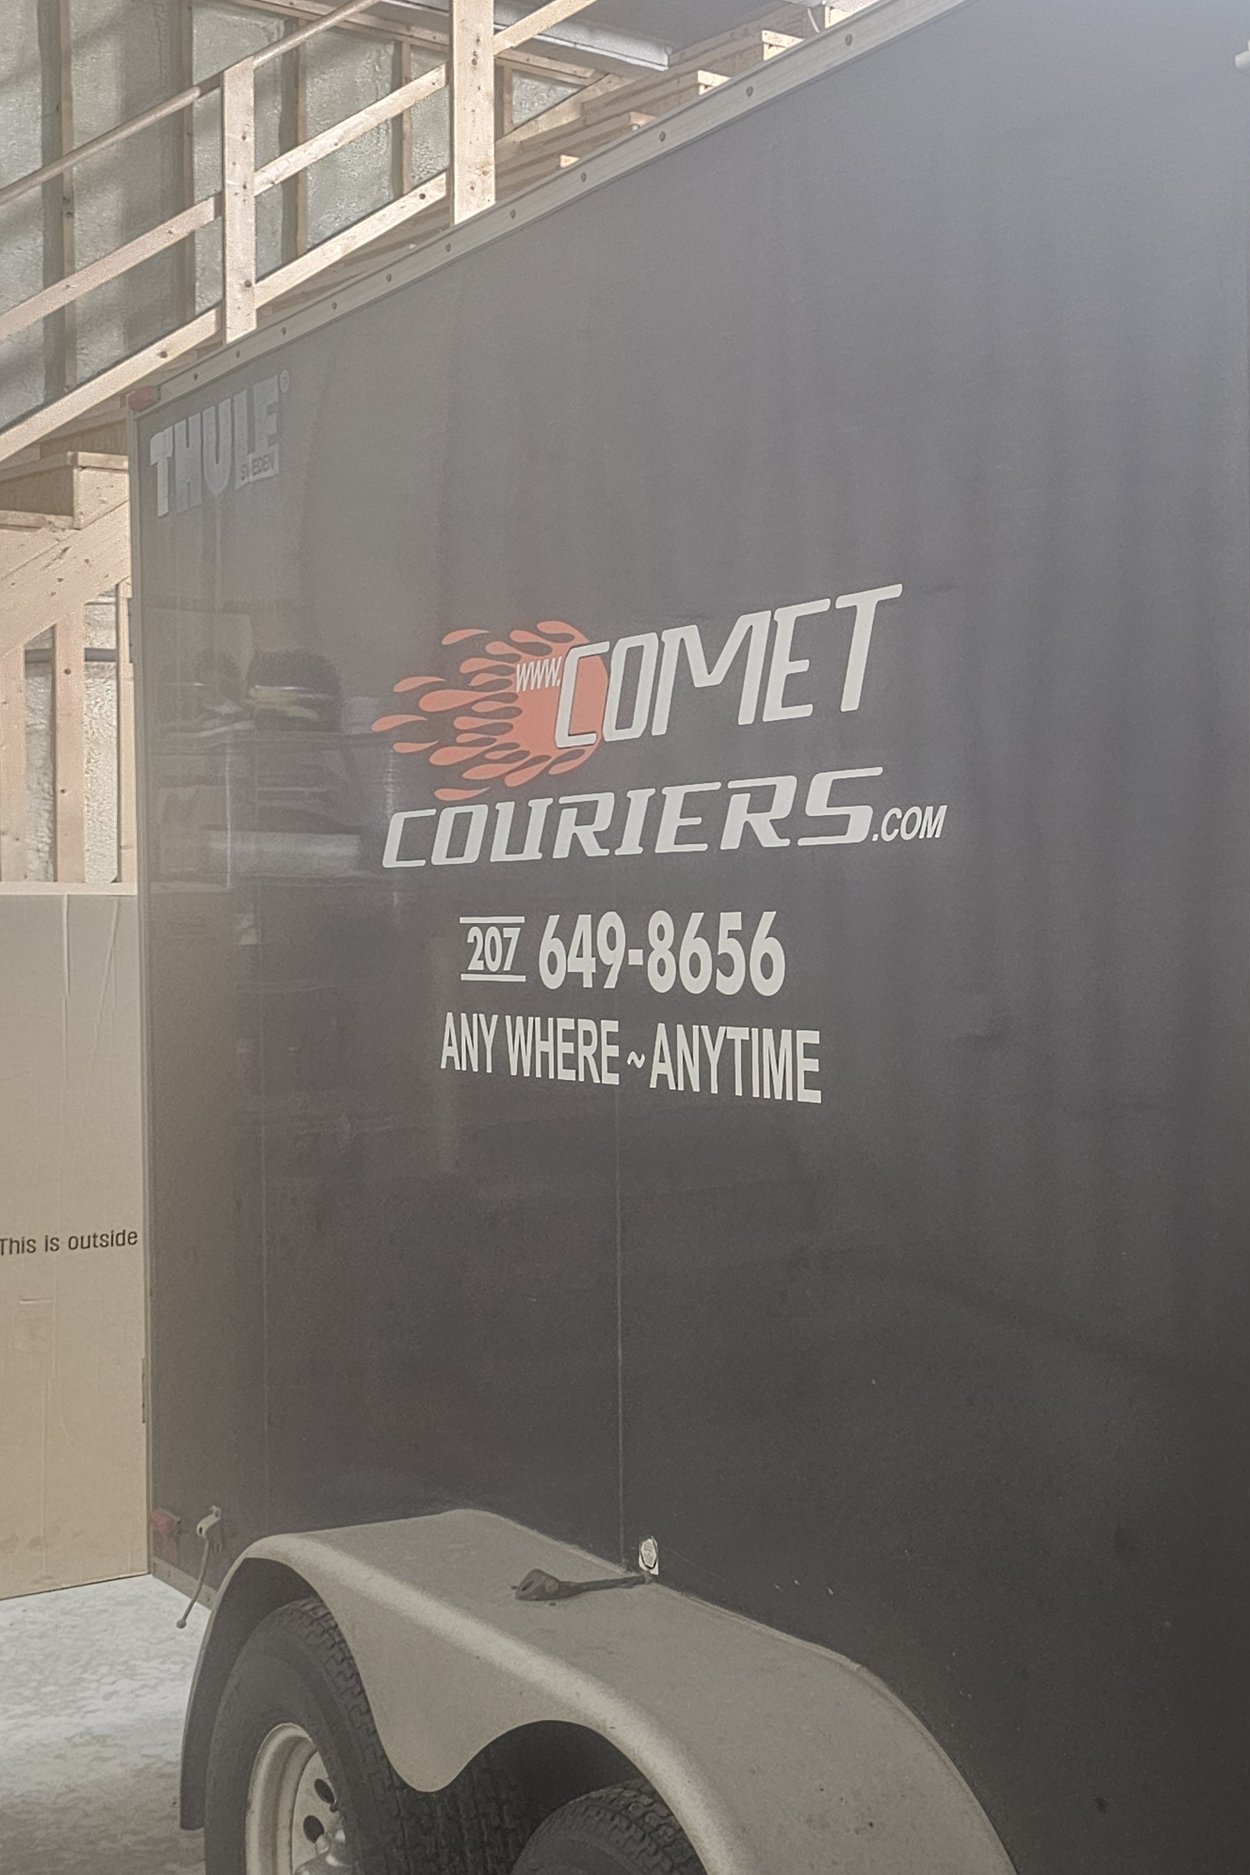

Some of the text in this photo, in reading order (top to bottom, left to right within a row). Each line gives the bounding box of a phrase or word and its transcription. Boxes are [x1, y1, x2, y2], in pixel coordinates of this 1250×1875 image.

[150, 375, 279, 517] THULE
[555, 583, 903, 748] COMET
[467, 910, 786, 997] 207 649-8656
[649, 1022, 822, 1104] ANYTIME
[0, 1229, 138, 1256] This is outside
